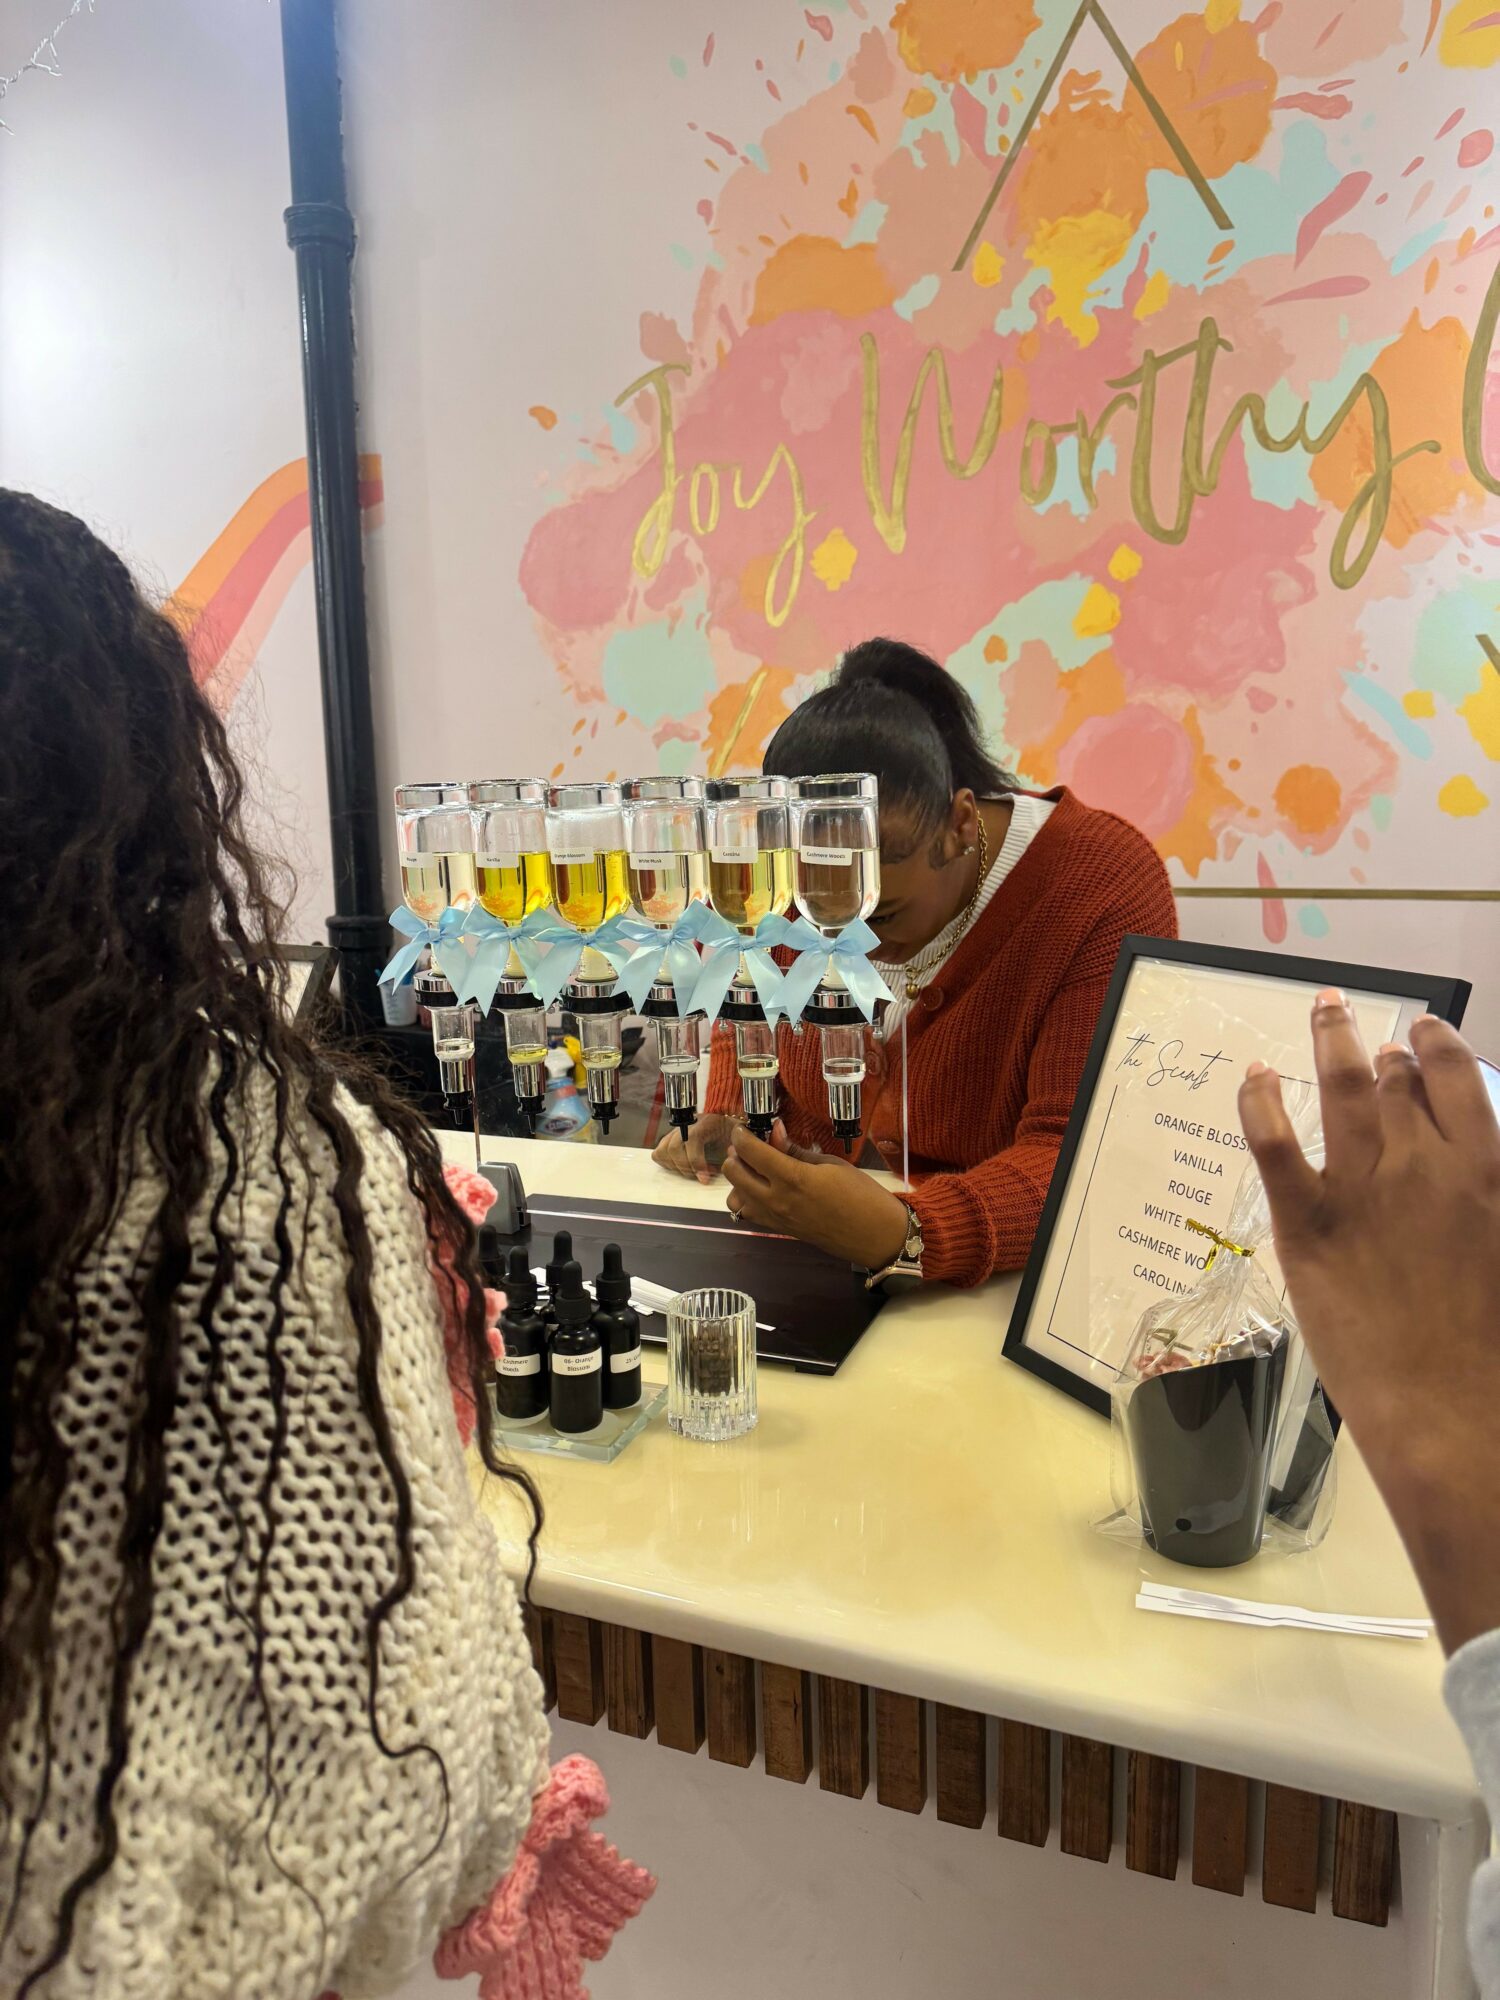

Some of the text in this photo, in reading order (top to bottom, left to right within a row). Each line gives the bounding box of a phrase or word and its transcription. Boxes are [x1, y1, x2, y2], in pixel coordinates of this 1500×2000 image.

[615, 363, 815, 628] Joy
[860, 317, 1441, 590] Worthy
[1146, 1040, 1233, 1091] Scents
[1154, 1112, 1250, 1152] ORANGE BLOSS
[1174, 1149, 1224, 1177] VANILLA
[1167, 1179, 1213, 1206] ROUGE
[1144, 1202, 1183, 1229] WHITE
[1118, 1225, 1208, 1271] CASHMERE WO
